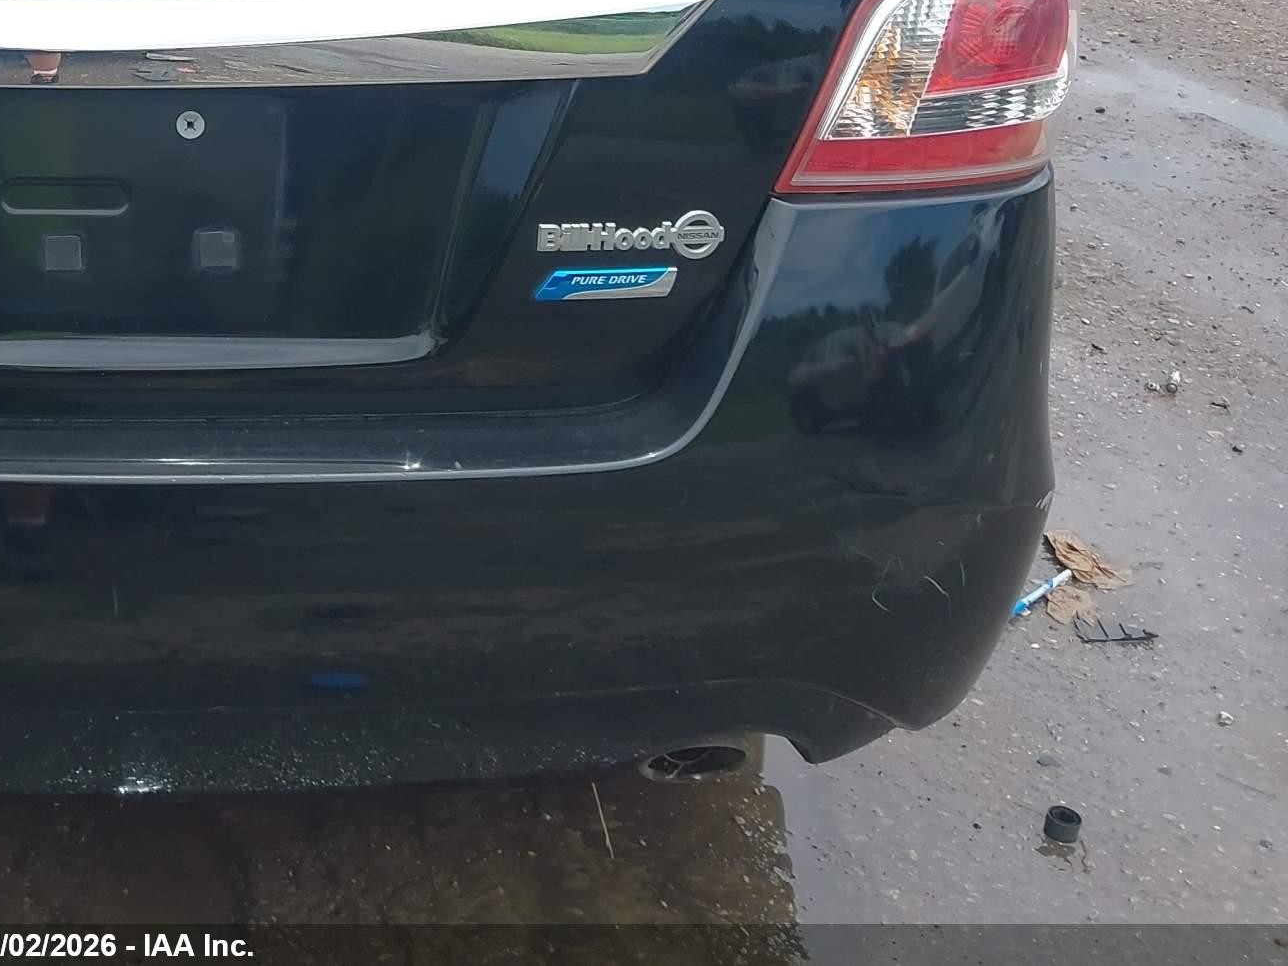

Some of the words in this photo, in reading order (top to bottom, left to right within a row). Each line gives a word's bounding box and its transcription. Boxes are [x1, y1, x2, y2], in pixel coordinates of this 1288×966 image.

[677, 231, 719, 240] NISSAN
[571, 276, 606, 285] PURE
[608, 274, 648, 284] DRIVE
